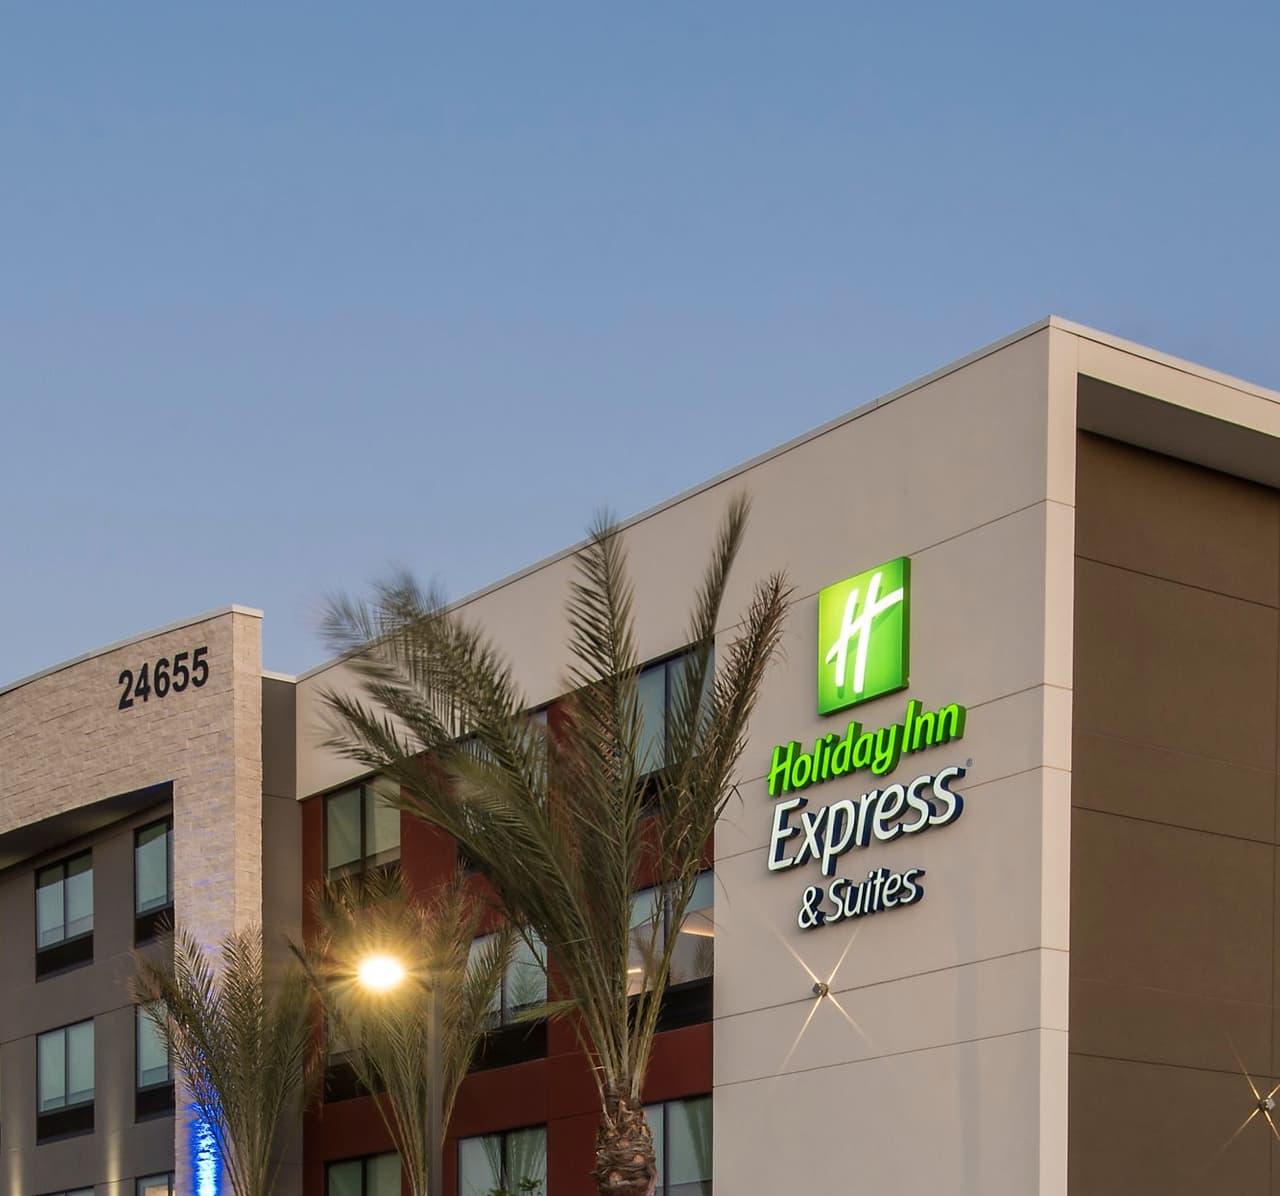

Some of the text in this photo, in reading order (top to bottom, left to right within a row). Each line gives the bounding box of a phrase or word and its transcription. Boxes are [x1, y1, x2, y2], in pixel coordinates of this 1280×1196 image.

[118, 646, 209, 710] 24655
[768, 700, 966, 796] Holiday Inn
[767, 765, 966, 876] Express
[797, 868, 924, 930] & Suites
